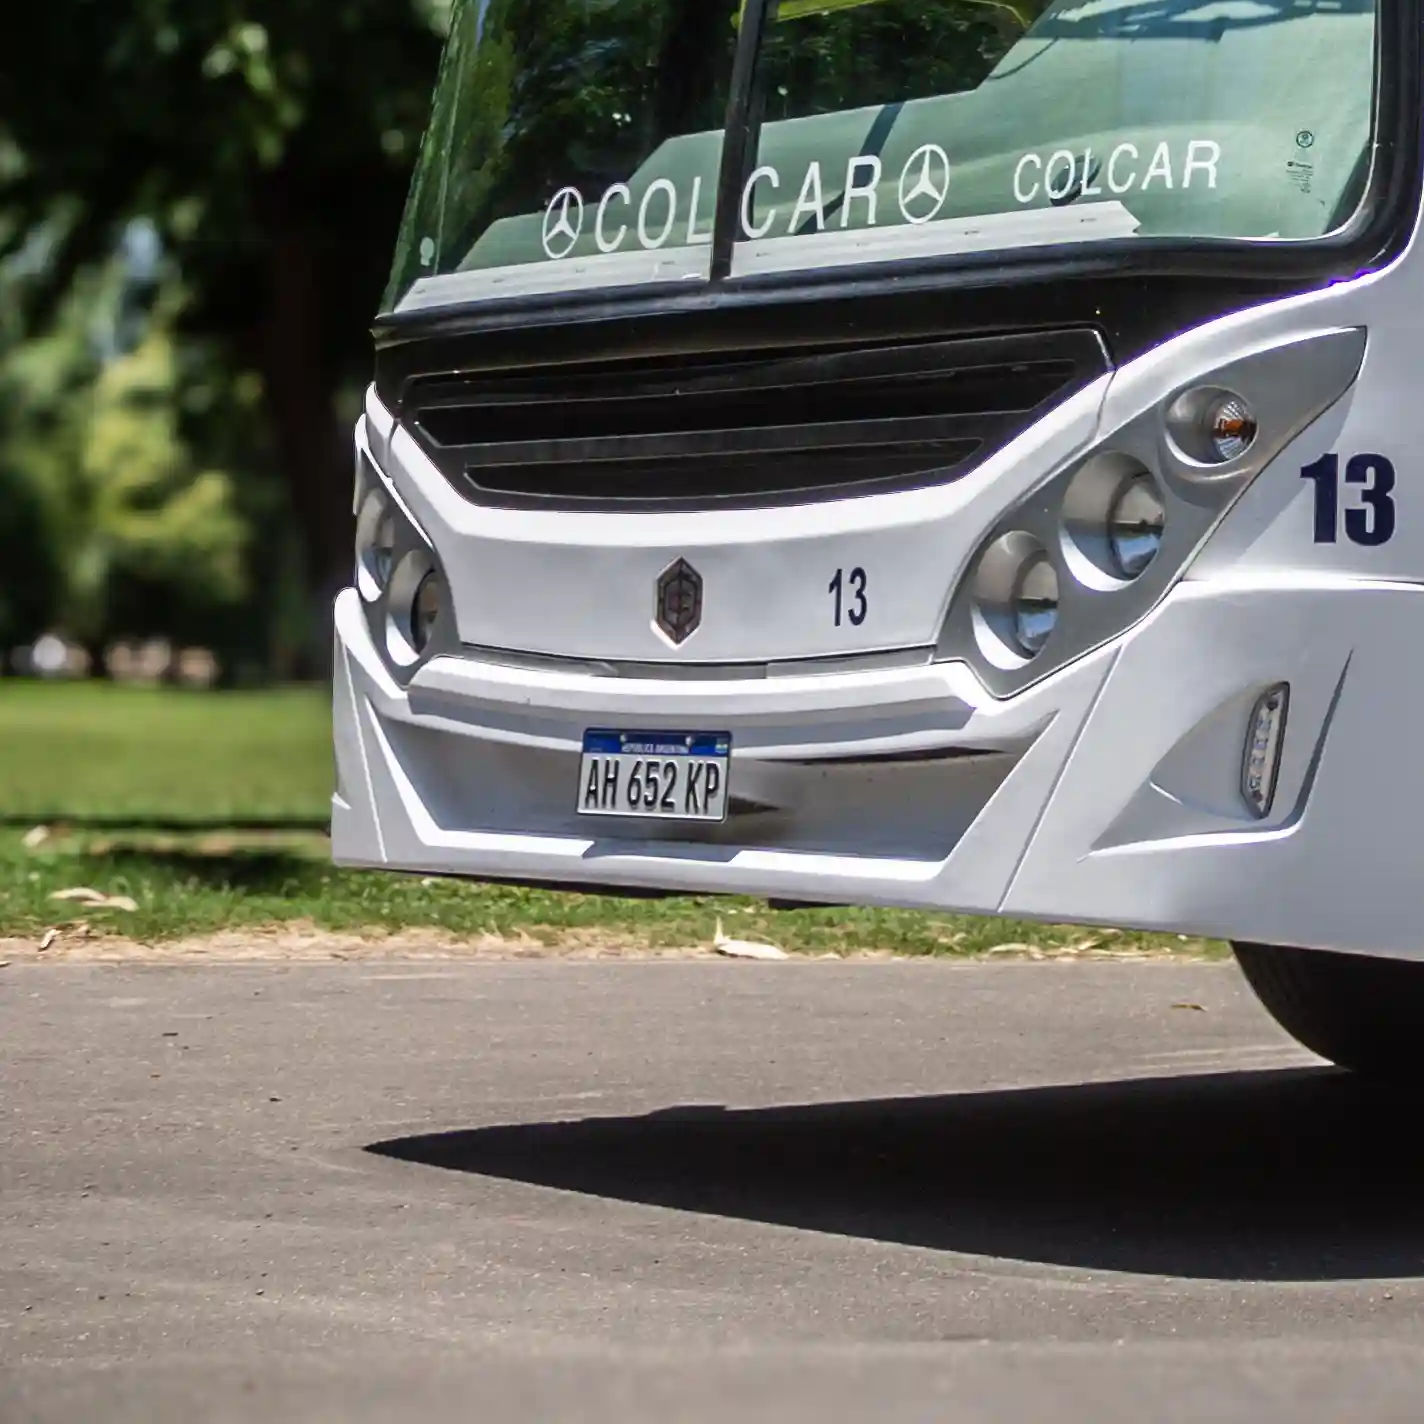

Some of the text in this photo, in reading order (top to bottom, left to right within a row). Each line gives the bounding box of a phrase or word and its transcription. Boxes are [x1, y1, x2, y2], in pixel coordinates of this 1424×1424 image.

[1013, 140, 1221, 203] COLCAR
[1300, 452, 1397, 546] 13
[828, 566, 868, 626] 13
[584, 758, 720, 815] AH 652 KP
